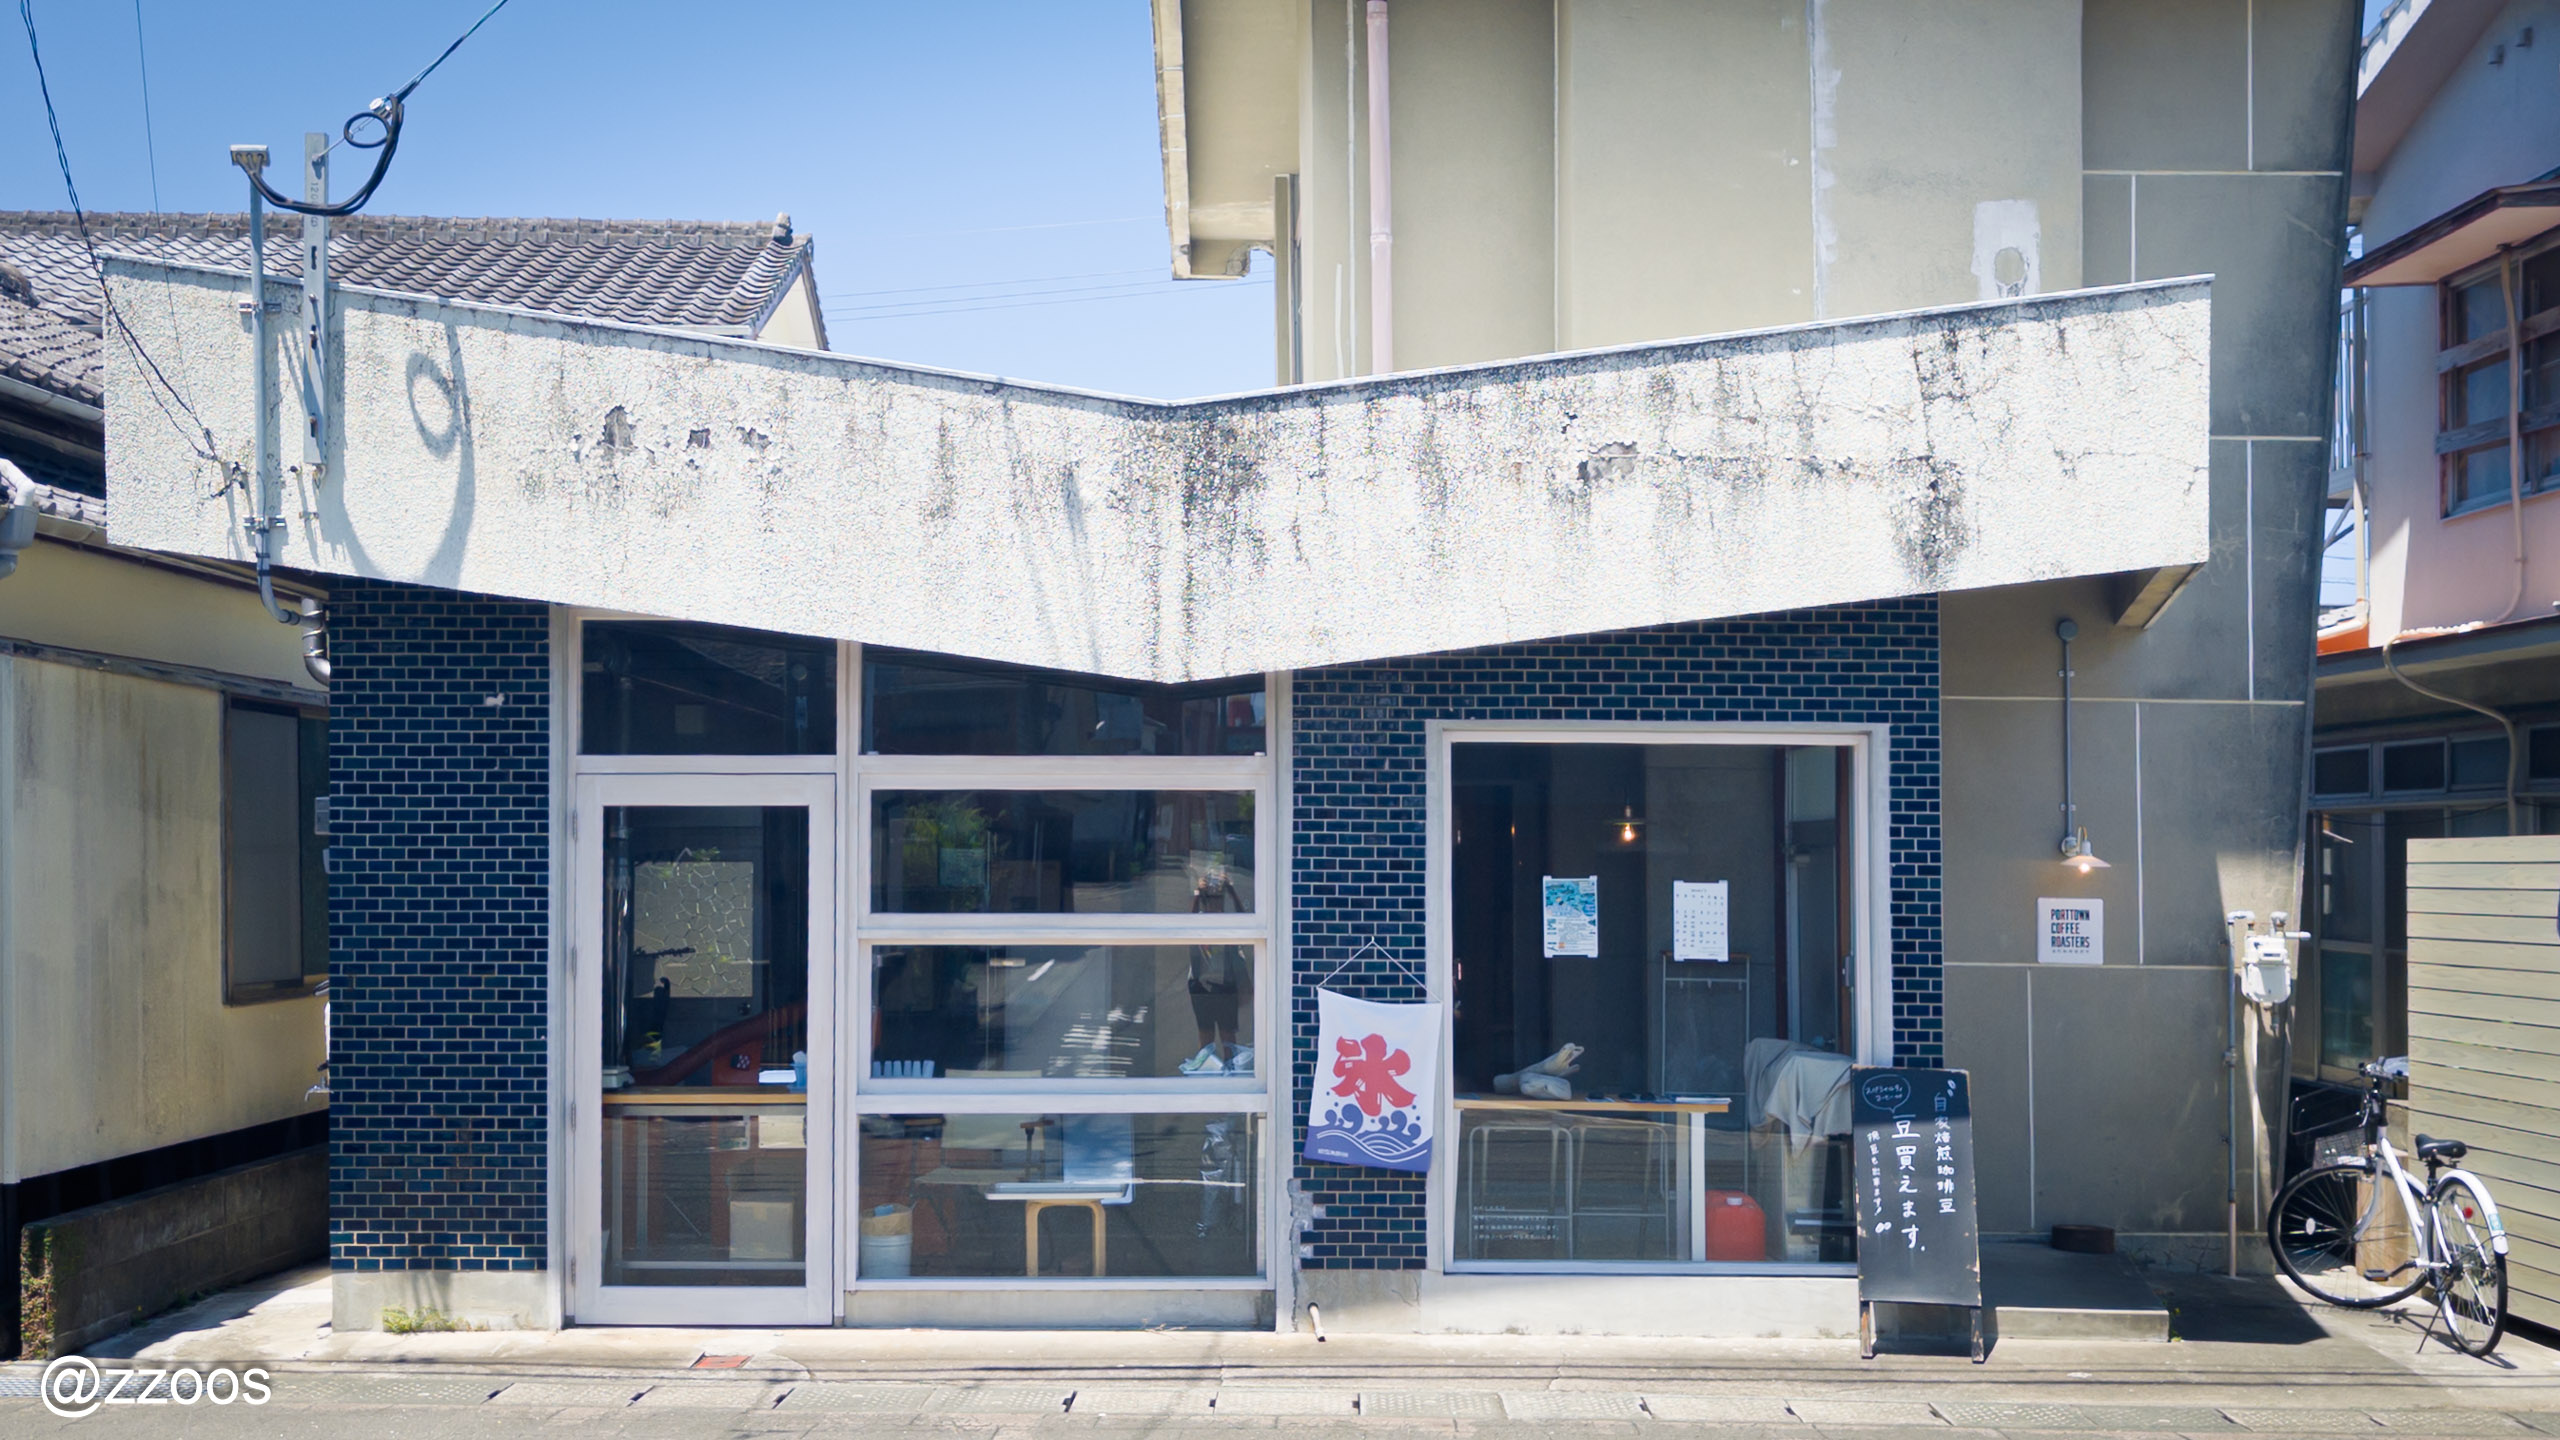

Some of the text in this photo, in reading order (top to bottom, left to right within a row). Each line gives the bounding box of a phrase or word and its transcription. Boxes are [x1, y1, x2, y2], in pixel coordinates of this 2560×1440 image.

[2051, 909, 2090, 921] PORTTOWN
[2051, 922, 2080, 934] COFFEE
[2051, 936, 2090, 948] ROASTERS
[1331, 1033, 1417, 1117] 氷
